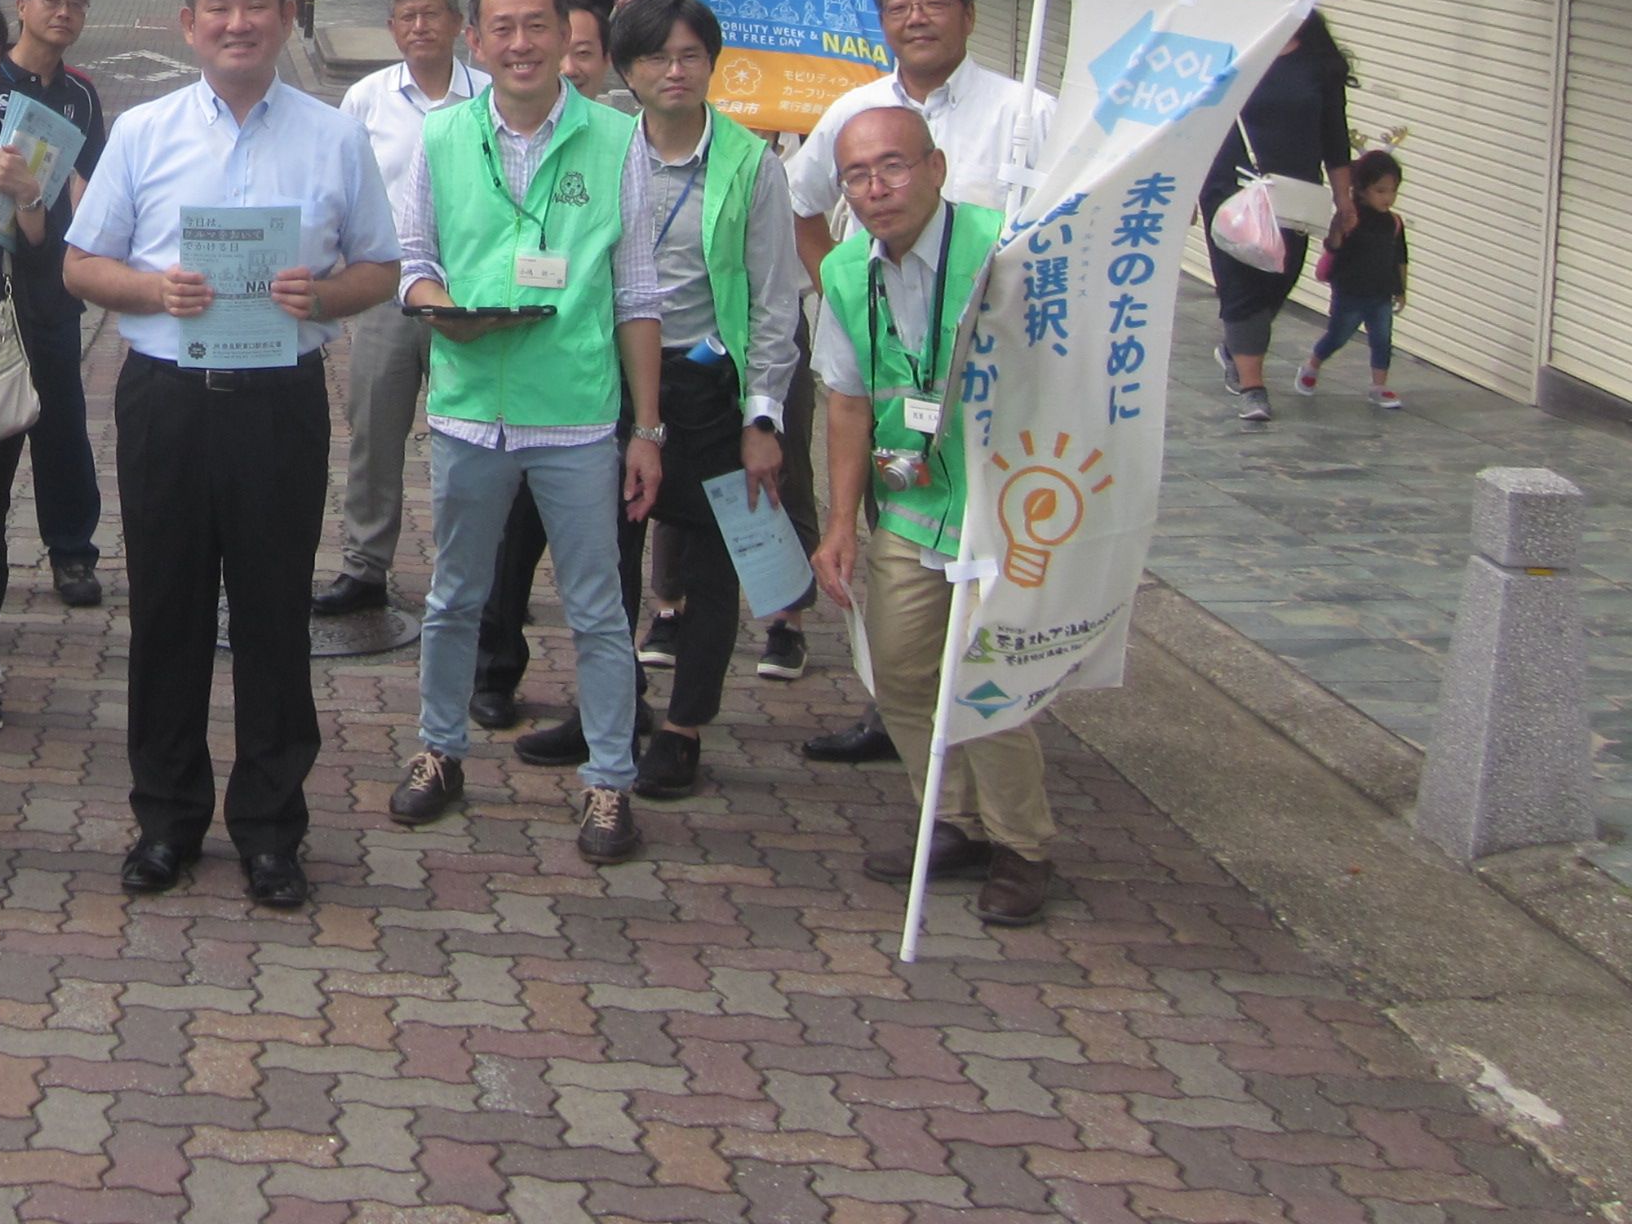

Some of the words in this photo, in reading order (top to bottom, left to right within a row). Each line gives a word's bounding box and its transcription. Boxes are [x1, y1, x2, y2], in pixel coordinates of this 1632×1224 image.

[719, 20, 769, 34] OBILITY
[773, 26, 805, 39] WEEK
[810, 31, 818, 41] &
[822, 31, 889, 66] NARA
[743, 33, 775, 46] FREE
[779, 38, 802, 48] DAY
[246, 281, 272, 293] NA
[1106, 172, 1176, 425] 未来のために
